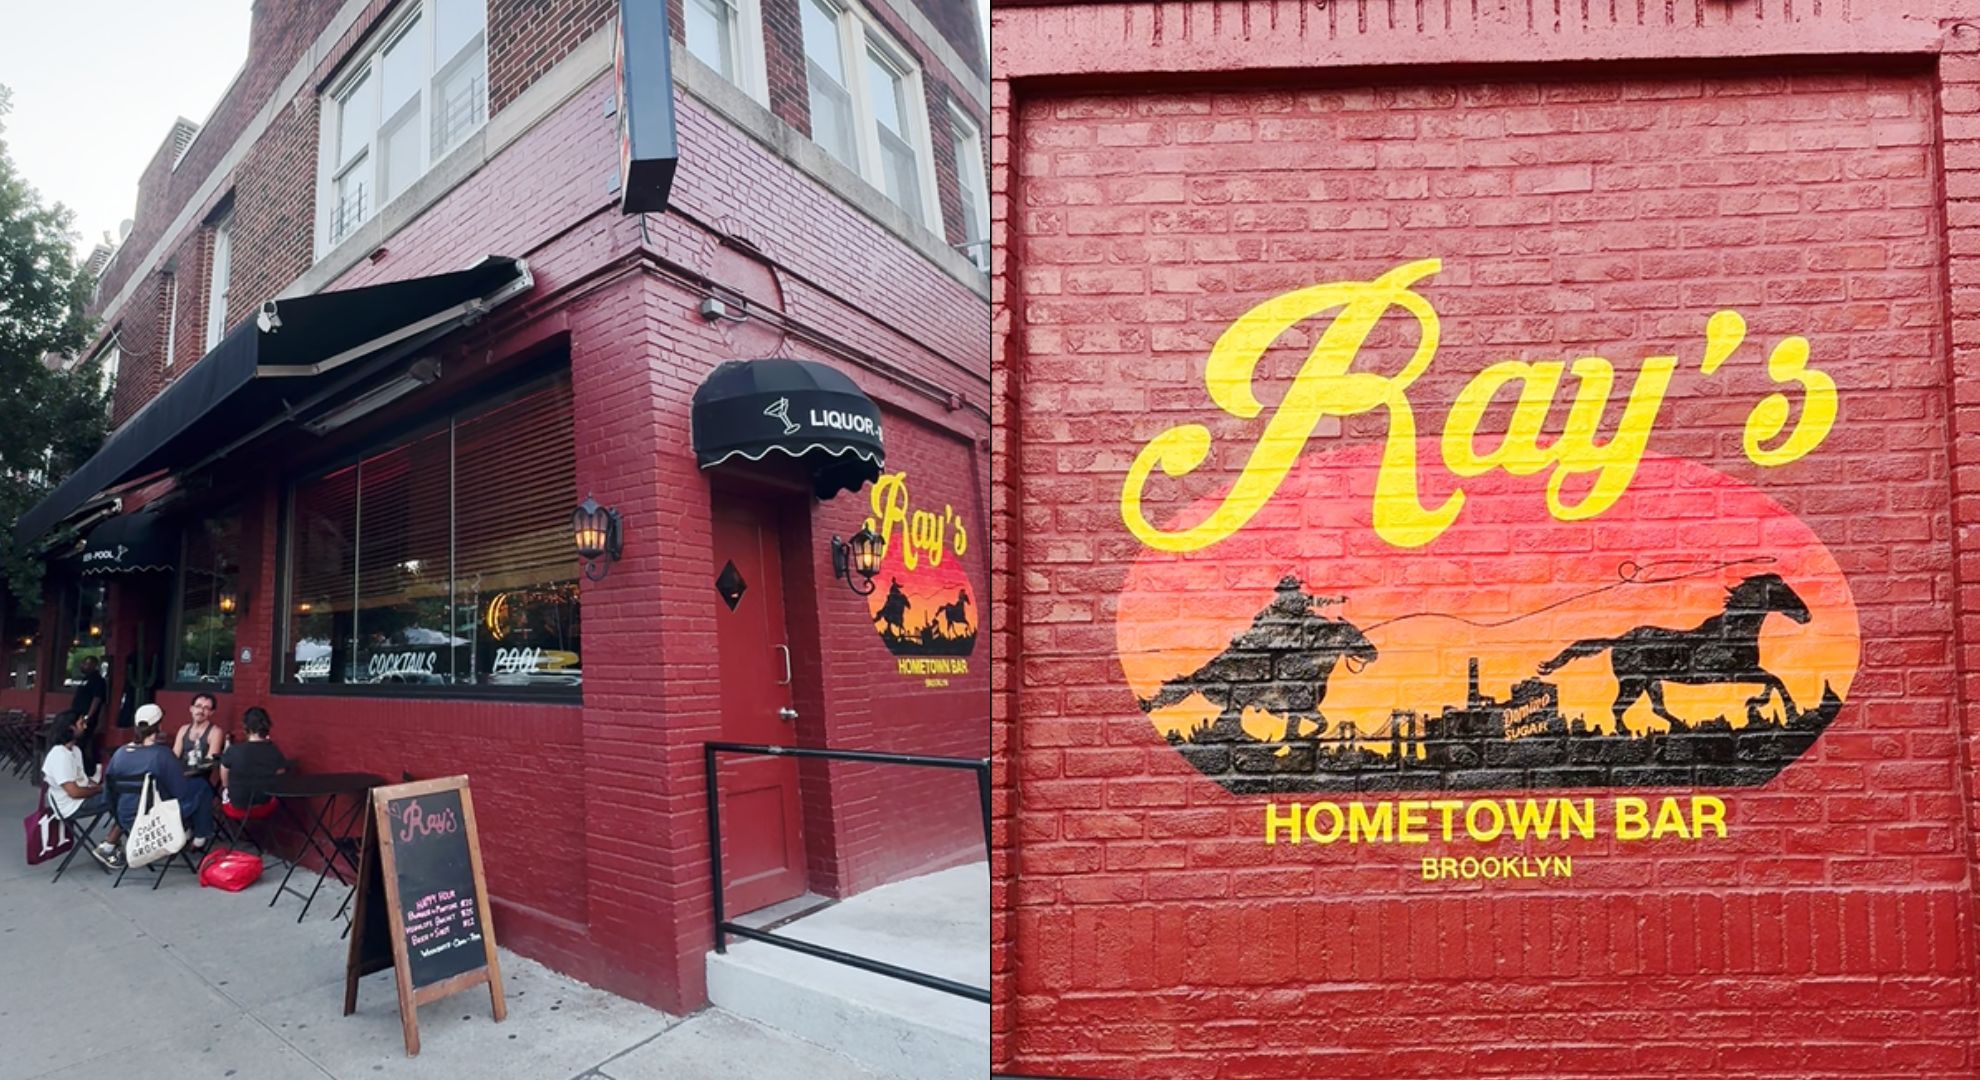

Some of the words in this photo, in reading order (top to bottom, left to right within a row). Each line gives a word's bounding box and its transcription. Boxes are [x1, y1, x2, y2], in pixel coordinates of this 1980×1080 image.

[1121, 258, 1839, 552] Ray's
[862, 471, 967, 570] Ray's
[369, 651, 437, 675] COCKTAILS
[493, 646, 541, 674] POOL
[898, 658, 951, 674] HOMETOWN
[951, 659, 969, 673] BAR
[1503, 692, 1550, 728] Domino
[400, 799, 457, 842] Ray's
[1265, 798, 1595, 844] HOMETOWN
[1615, 796, 1727, 840] BAR
[132, 833, 173, 857] GROCERS
[1422, 855, 1573, 880] BROOKLYN
